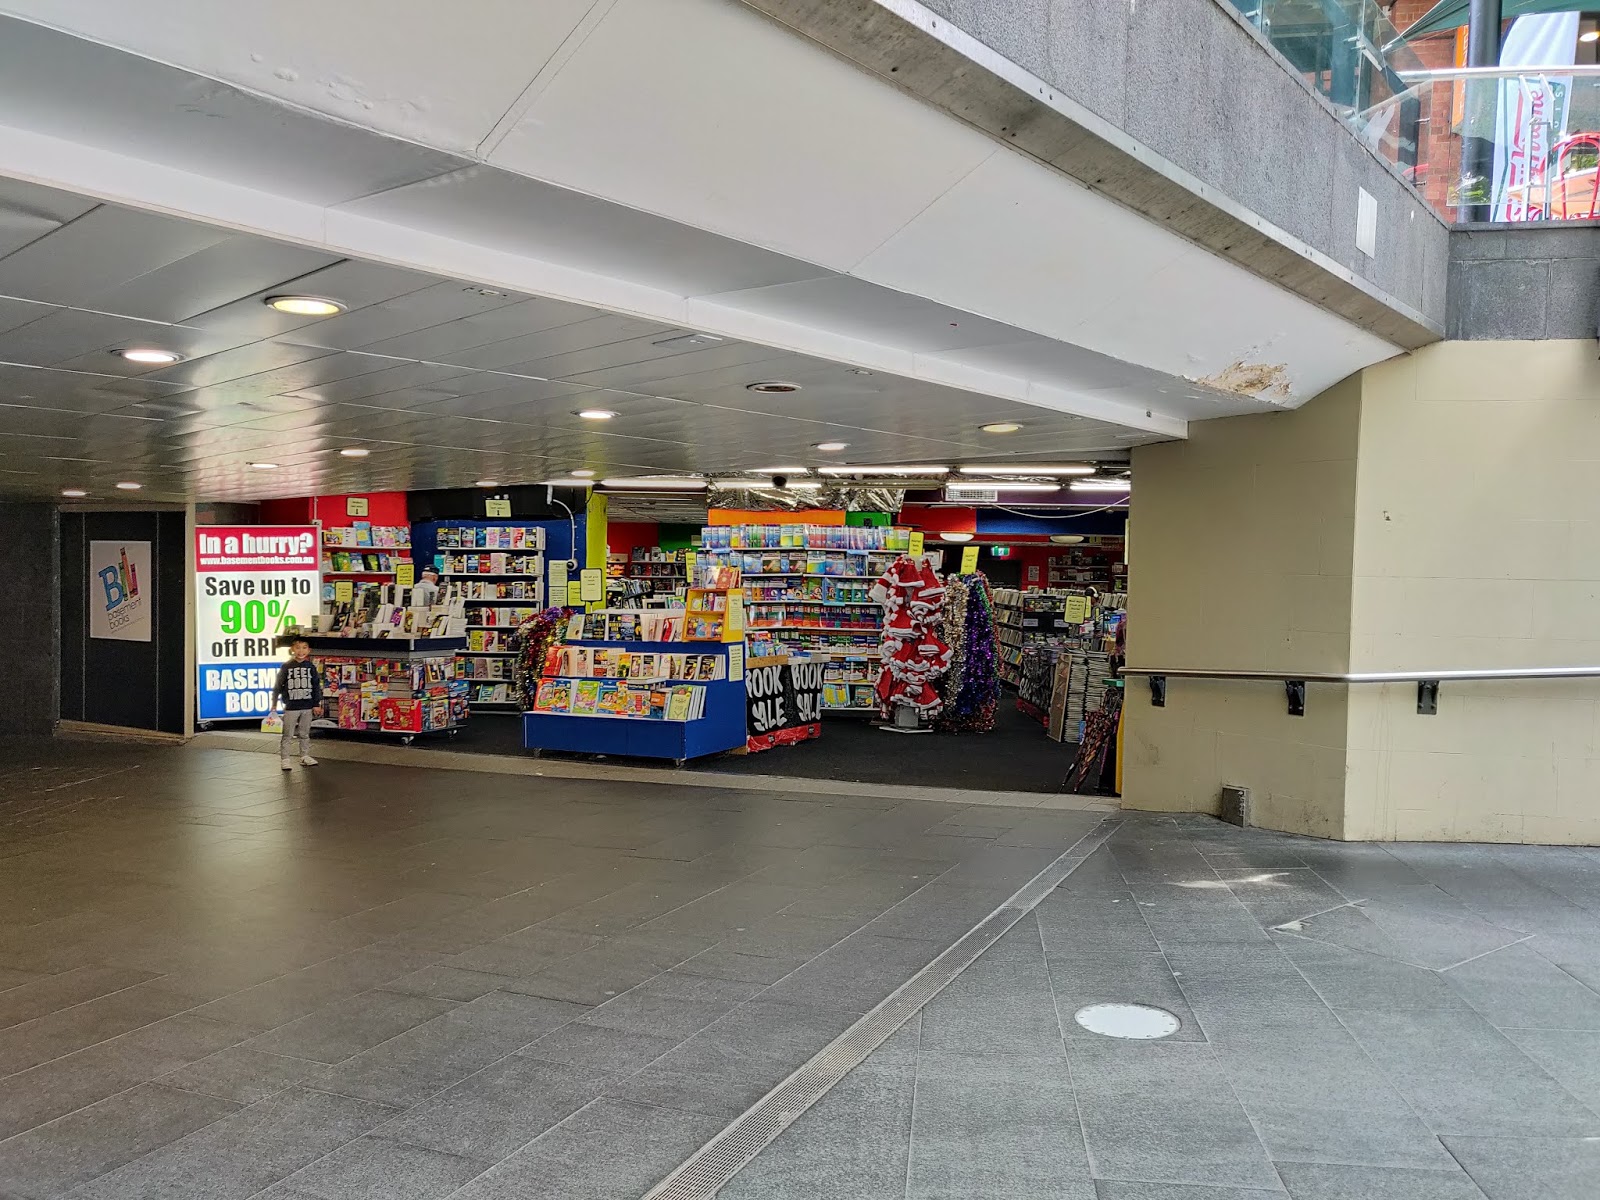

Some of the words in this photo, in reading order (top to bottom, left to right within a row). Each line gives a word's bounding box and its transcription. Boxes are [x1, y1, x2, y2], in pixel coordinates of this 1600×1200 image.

[199, 533, 221, 554] In
[225, 536, 239, 554] a
[242, 532, 314, 556] hurry?
[200, 556, 315, 566] www.basementbooks.com.au
[205, 576, 255, 597] Save
[261, 579, 286, 597] up
[291, 577, 311, 595] to
[220, 600, 297, 634] 90%
[212, 638, 239, 658] off
[205, 668, 280, 691] BASEM
[287, 667, 313, 679] FEEL
[791, 663, 824, 691] BOOK
[752, 696, 788, 731] SALE
